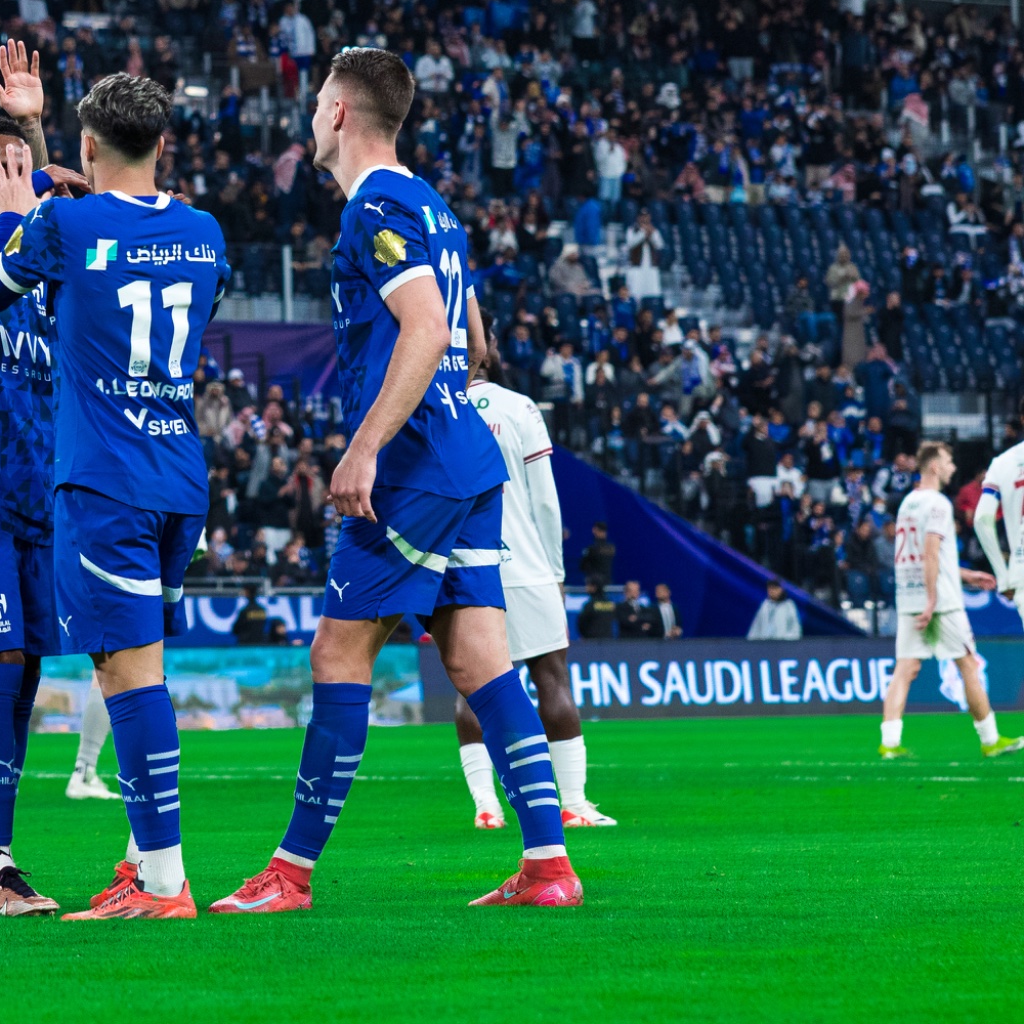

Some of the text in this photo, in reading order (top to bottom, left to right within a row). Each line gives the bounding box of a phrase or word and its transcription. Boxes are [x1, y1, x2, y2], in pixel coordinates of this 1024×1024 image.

[126, 244, 217, 267] بنك الرياض
[117, 280, 193, 378] 11
[24, 368, 52, 382] GROU
[639, 660, 754, 706] SAUDI
[759, 658, 895, 704] LEAGUE
